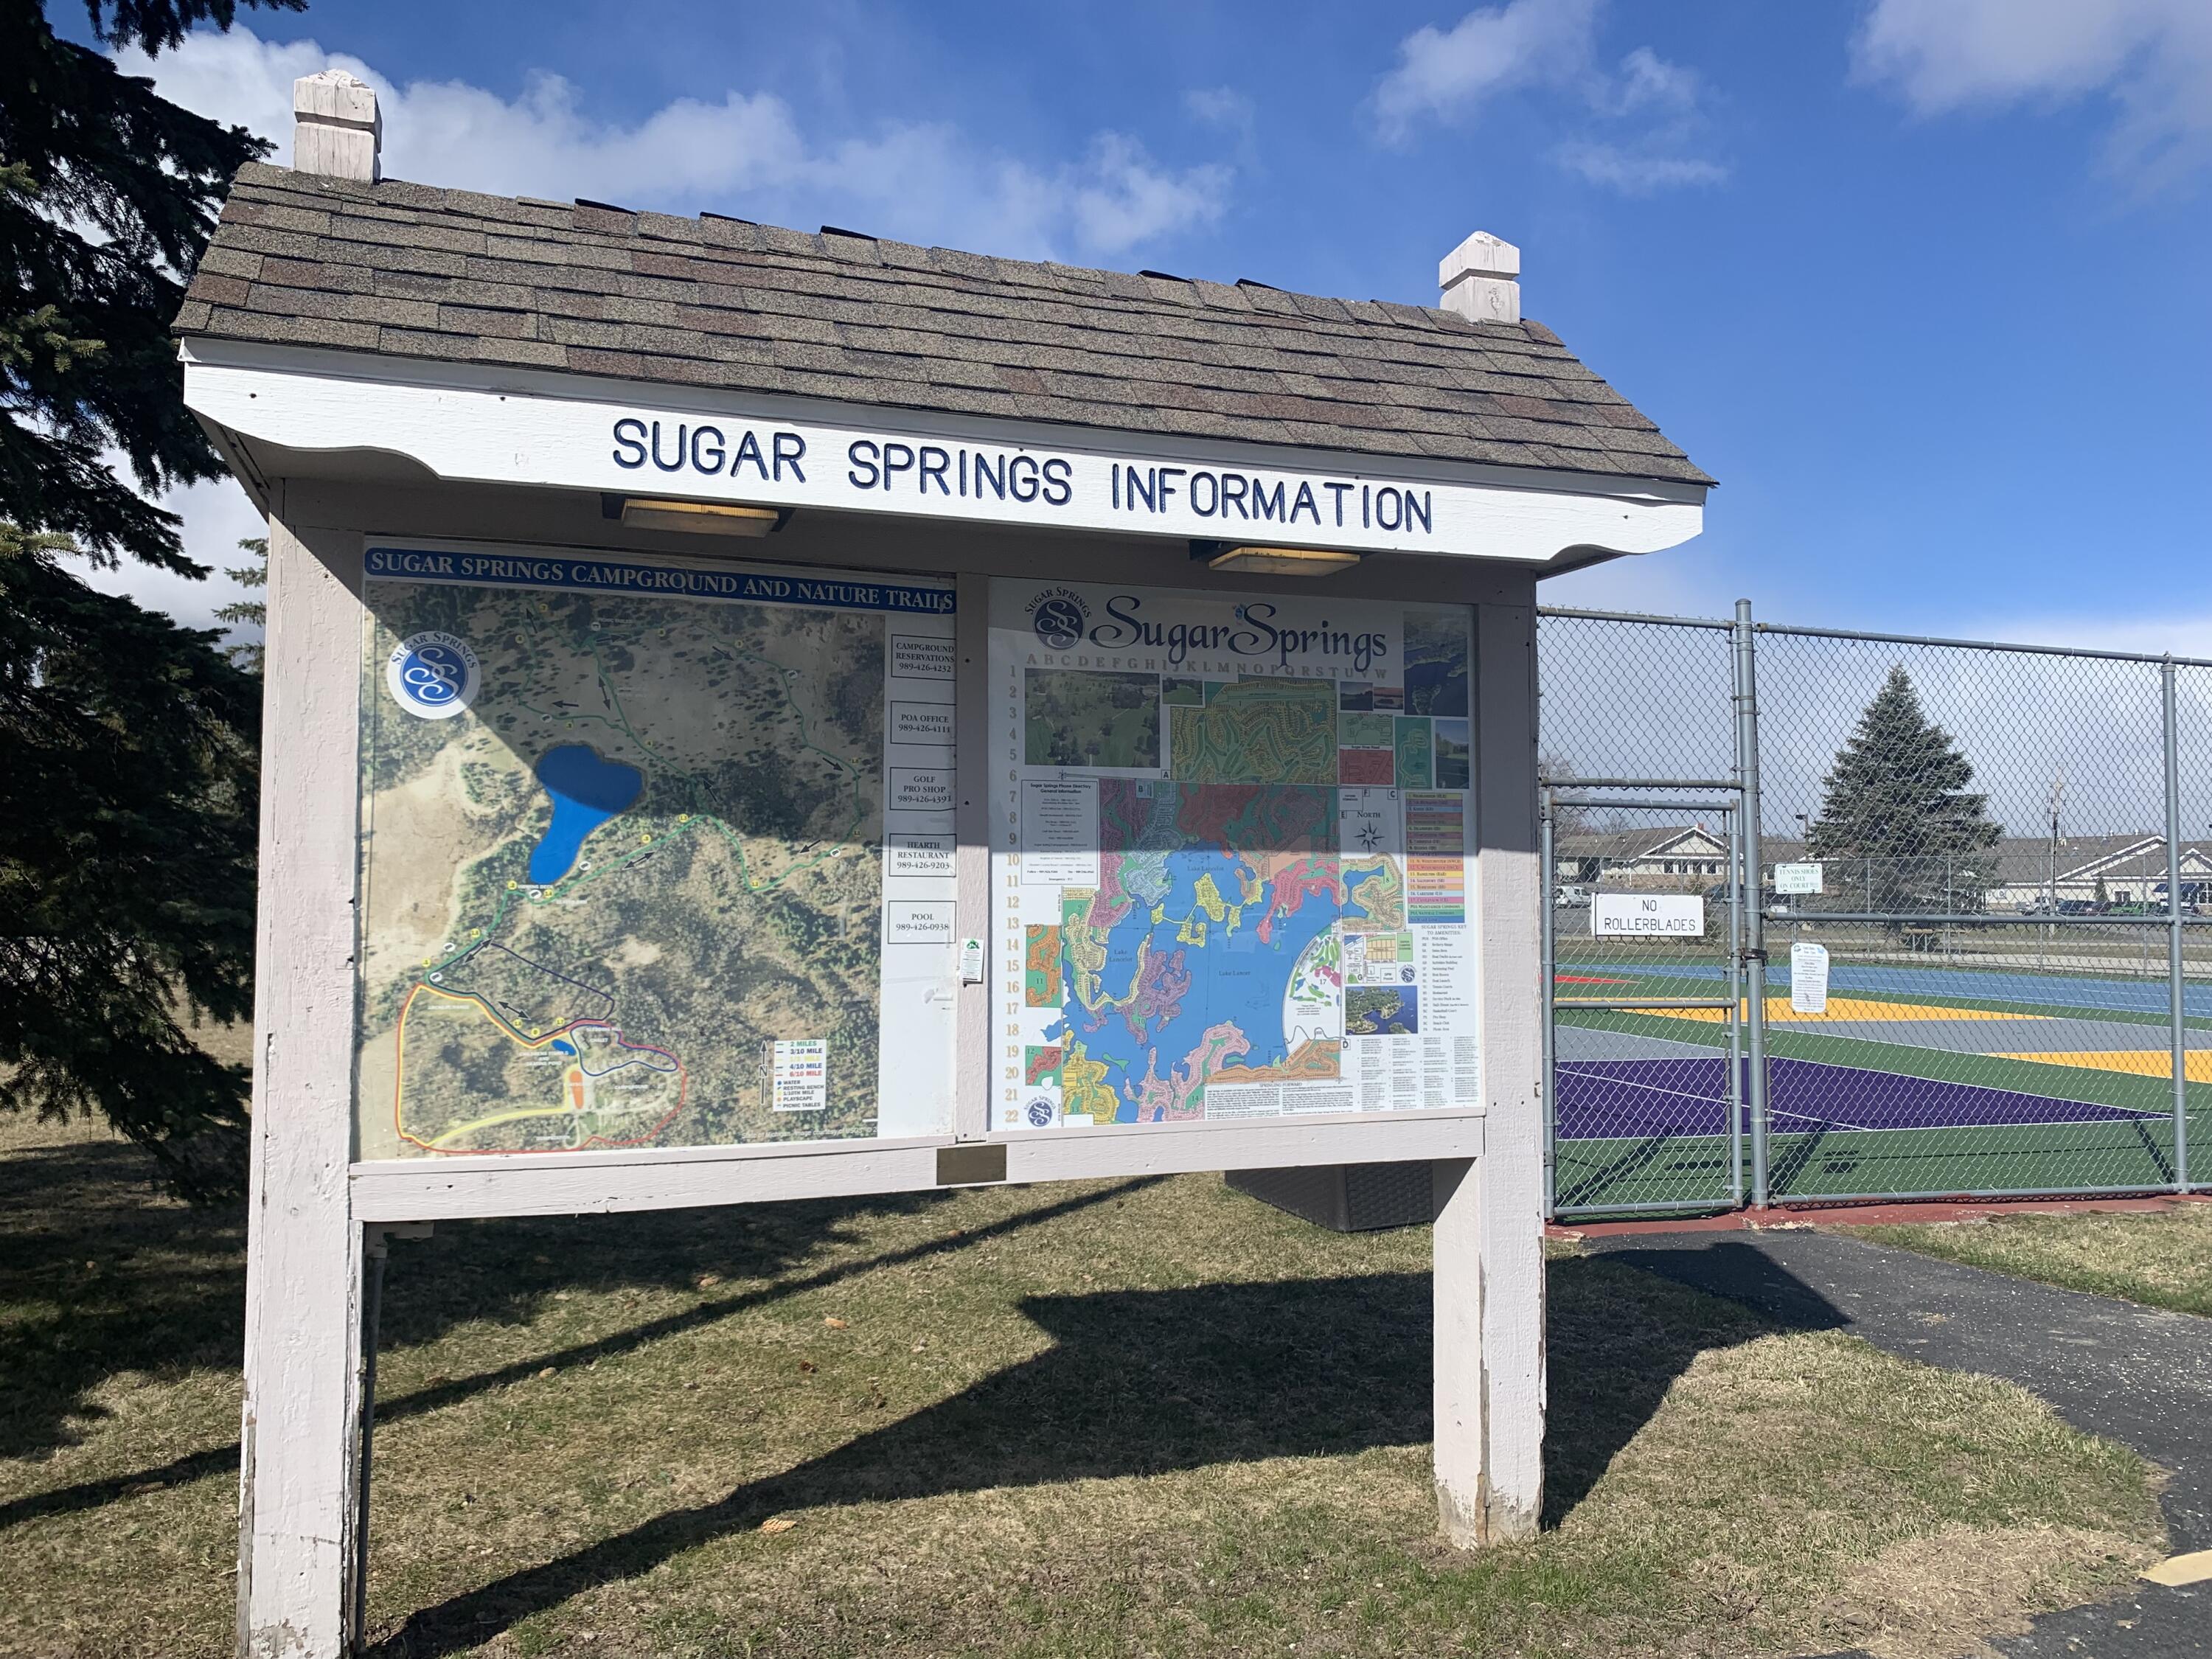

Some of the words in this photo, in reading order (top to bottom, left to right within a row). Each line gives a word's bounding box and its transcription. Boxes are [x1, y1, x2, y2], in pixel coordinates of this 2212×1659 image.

[612, 420, 807, 484] SUGAR
[848, 442, 1074, 507] SPRINGS
[1110, 462, 1433, 535] INFORMATION
[371, 552, 455, 574] SUGAR
[460, 558, 564, 581] SPRINGS
[571, 564, 738, 594] CAMPGROUND
[742, 578, 791, 598] AND
[796, 582, 880, 605] NATURE
[886, 589, 954, 610] TRAILS
[1025, 589, 1054, 615] SUGAR
[1056, 586, 1091, 618] SPRINGS
[1089, 595, 1230, 664] Sugar
[1227, 602, 1388, 672] Springs
[392, 635, 428, 664] SUGAR
[433, 632, 477, 668] SPRINGS
[897, 643, 954, 653] CAMPGROUND
[896, 653, 955, 663] RESERVATIONS
[900, 662, 951, 672] 989-426-4232
[1011, 665, 1015, 678] 1
[1027, 655, 1037, 665] A
[1044, 655, 1054, 665] B
[1061, 655, 1071, 666] C
[1078, 656, 1088, 667] D
[1096, 657, 1105, 667] E
[1113, 658, 1121, 668] F
[1127, 658, 1138, 669] G
[1144, 659, 1155, 669] H
[1162, 660, 1167, 670] I
[1186, 661, 1196, 672] K
[1203, 661, 1211, 672] L
[1217, 662, 1229, 673] M
[1237, 664, 1246, 674] N
[1253, 664, 1263, 674] O
[1271, 665, 1280, 675] P
[1285, 666, 1295, 676] Q
[1302, 666, 1311, 676] R
[1316, 667, 1324, 677] S
[1329, 667, 1338, 677] T
[1345, 668, 1354, 678] U
[1376, 669, 1387, 679] W
[1009, 686, 1017, 698] 2
[1009, 707, 1017, 719] 3
[899, 724, 950, 732] 989-426-4111
[1009, 727, 1016, 740] 4
[1009, 749, 1016, 761] 5
[1009, 769, 1017, 782] 6
[1009, 790, 1017, 802] 7
[1009, 812, 1017, 824] 8
[1009, 832, 1017, 845] 9
[897, 861, 950, 869] 989-426-9203
[1007, 854, 1020, 866] 10
[1007, 875, 1018, 887] 11
[1007, 896, 1019, 908] 12
[1642, 900, 1657, 912] NO
[897, 923, 949, 931] 989-426-0938
[1007, 917, 1019, 929] 13
[1604, 917, 1696, 932] ROLLERBLADES
[1006, 939, 1019, 950] 14
[1006, 960, 1019, 973] 15
[1006, 981, 1019, 993] 16
[1006, 1002, 1019, 1015] 17
[1006, 1023, 1019, 1036] 18
[1006, 1045, 1019, 1057] 19
[759, 1066, 768, 1077] N
[1006, 1066, 1019, 1079] 20
[1006, 1088, 1018, 1101] 21
[1006, 1110, 1018, 1123] 22
